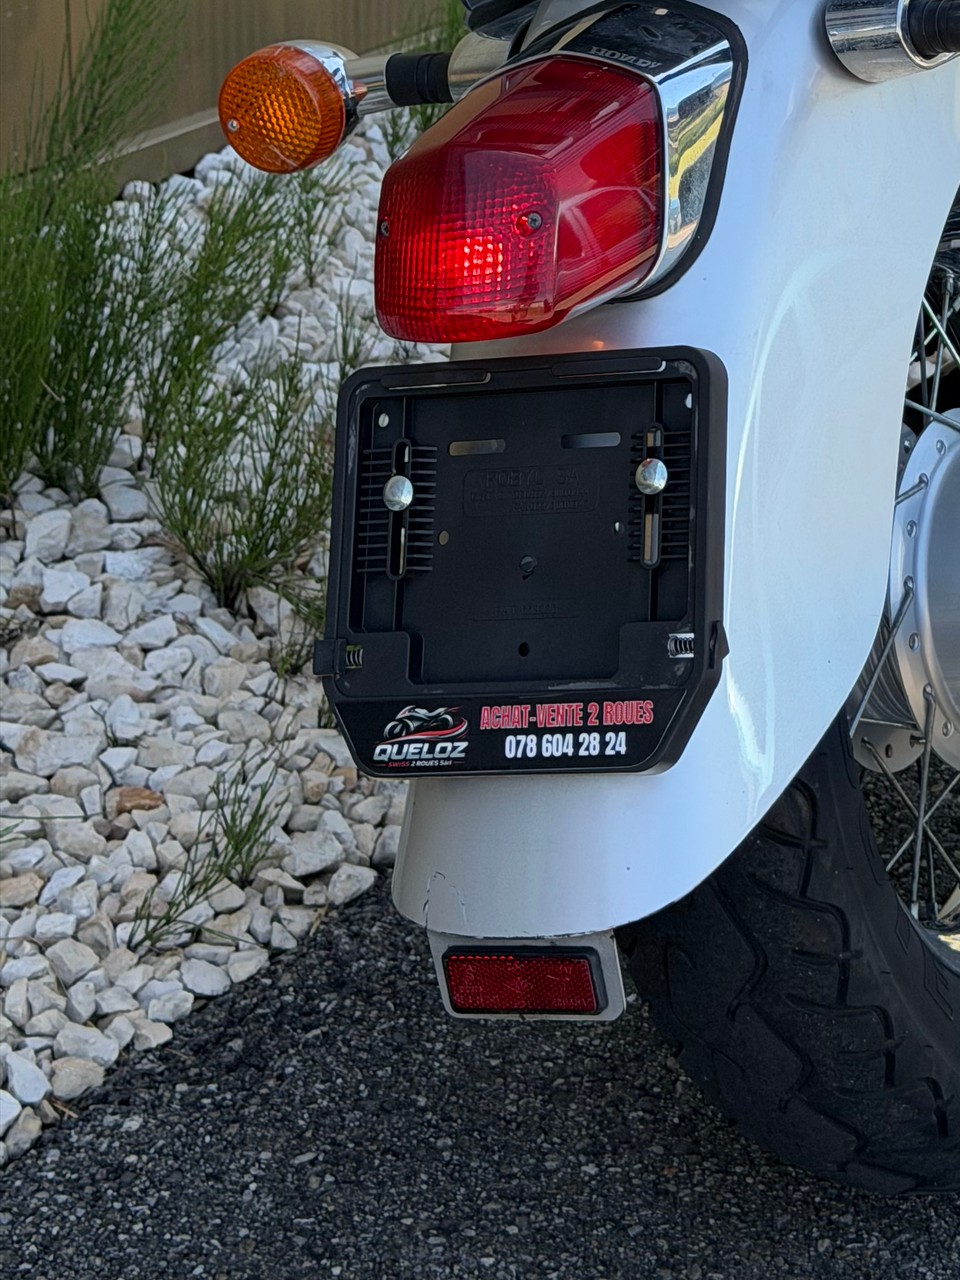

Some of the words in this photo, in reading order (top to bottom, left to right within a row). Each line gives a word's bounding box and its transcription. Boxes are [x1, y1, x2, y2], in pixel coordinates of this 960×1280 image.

[589, 46, 662, 68] HONDA
[480, 703, 583, 730] ACHAT-VENTE
[587, 702, 599, 726] 2
[603, 700, 653, 725] ROUES
[373, 741, 468, 761] QUELOZ
[505, 734, 537, 758] 078
[541, 733, 574, 757] 604
[578, 732, 600, 756] 28
[605, 731, 627, 755] 24
[416, 759, 438, 767] ROUES
